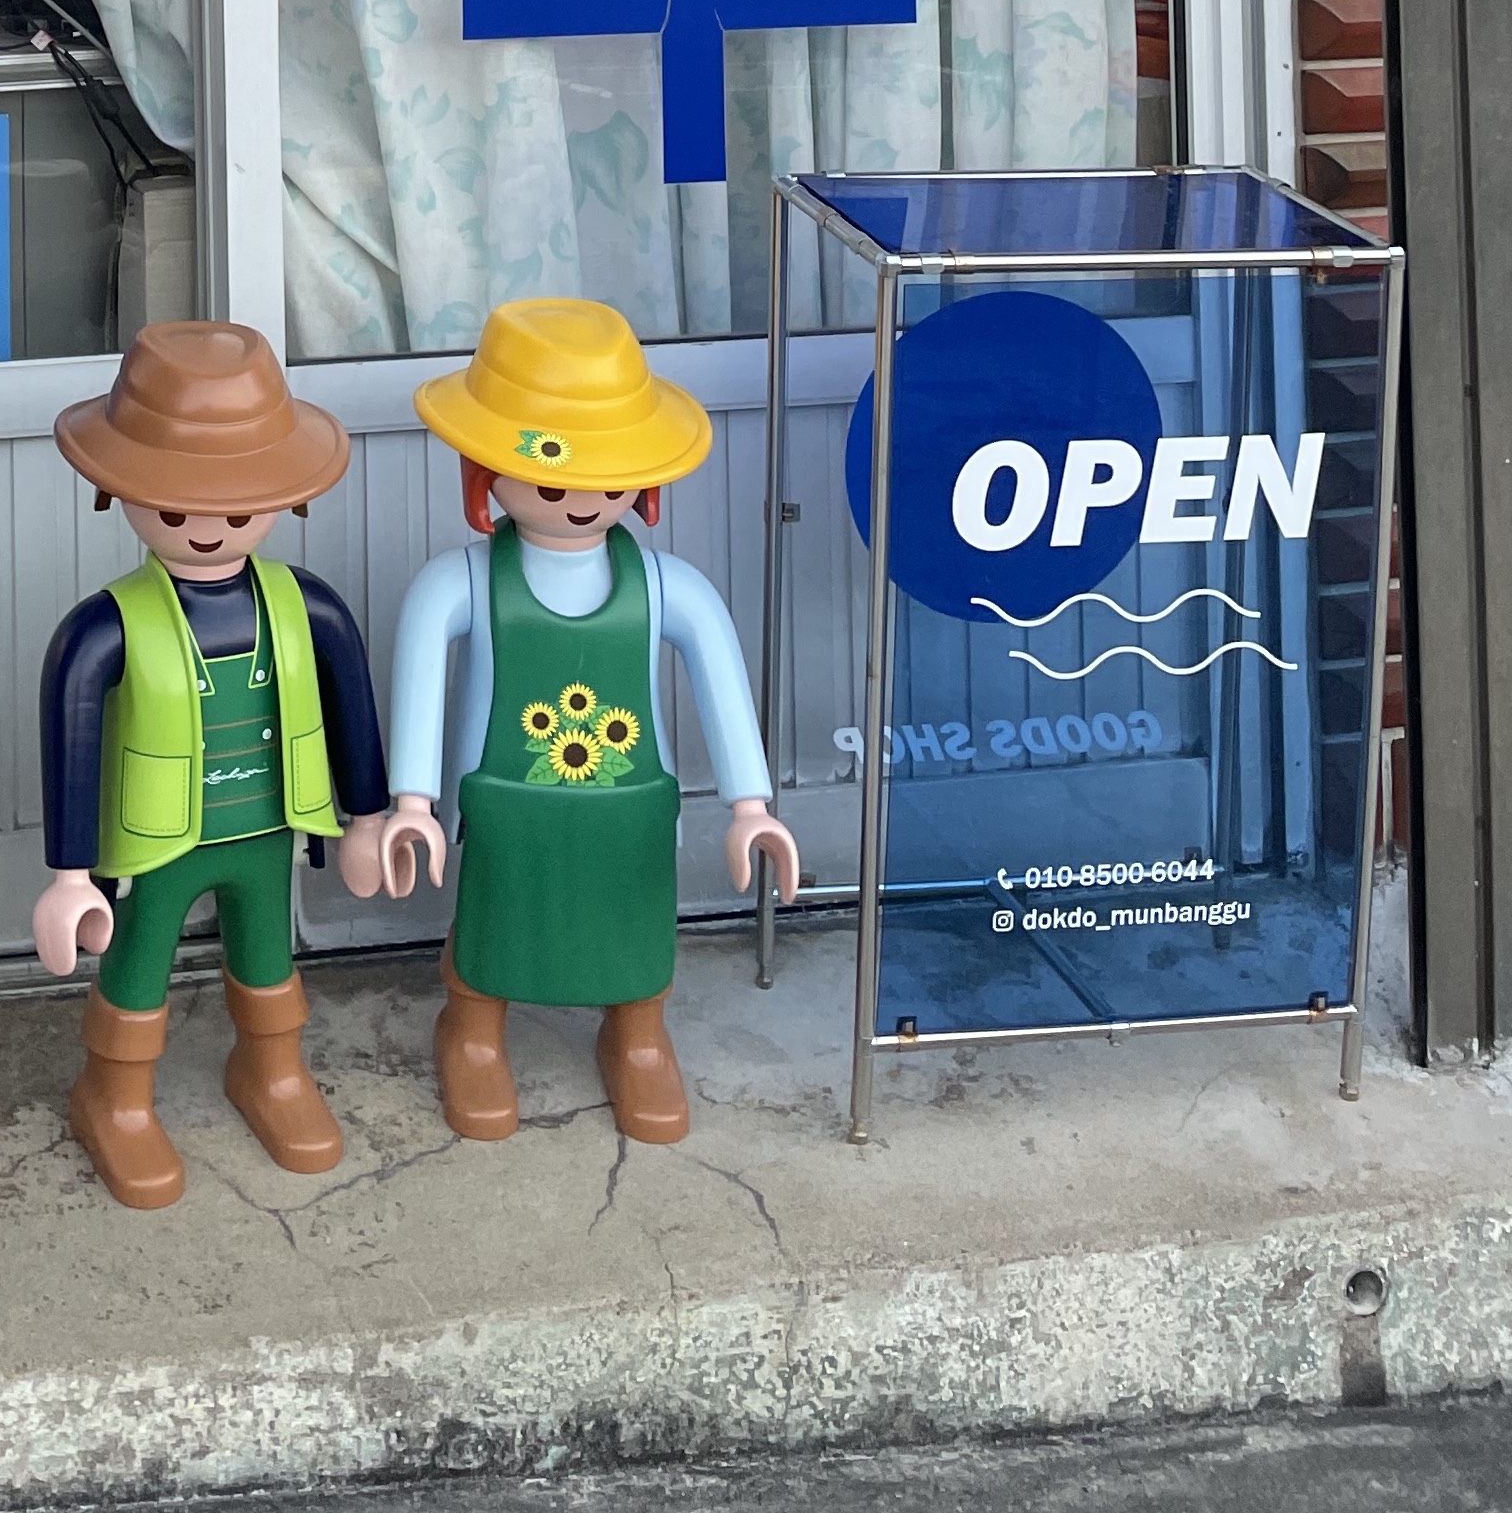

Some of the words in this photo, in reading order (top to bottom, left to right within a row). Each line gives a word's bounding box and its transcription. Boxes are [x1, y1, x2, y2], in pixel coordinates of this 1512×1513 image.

[951, 432, 1326, 552] OPEN
[1025, 858, 1215, 888] 010-8500-6044
[1022, 901, 1251, 931] dokdo_munbanggu
